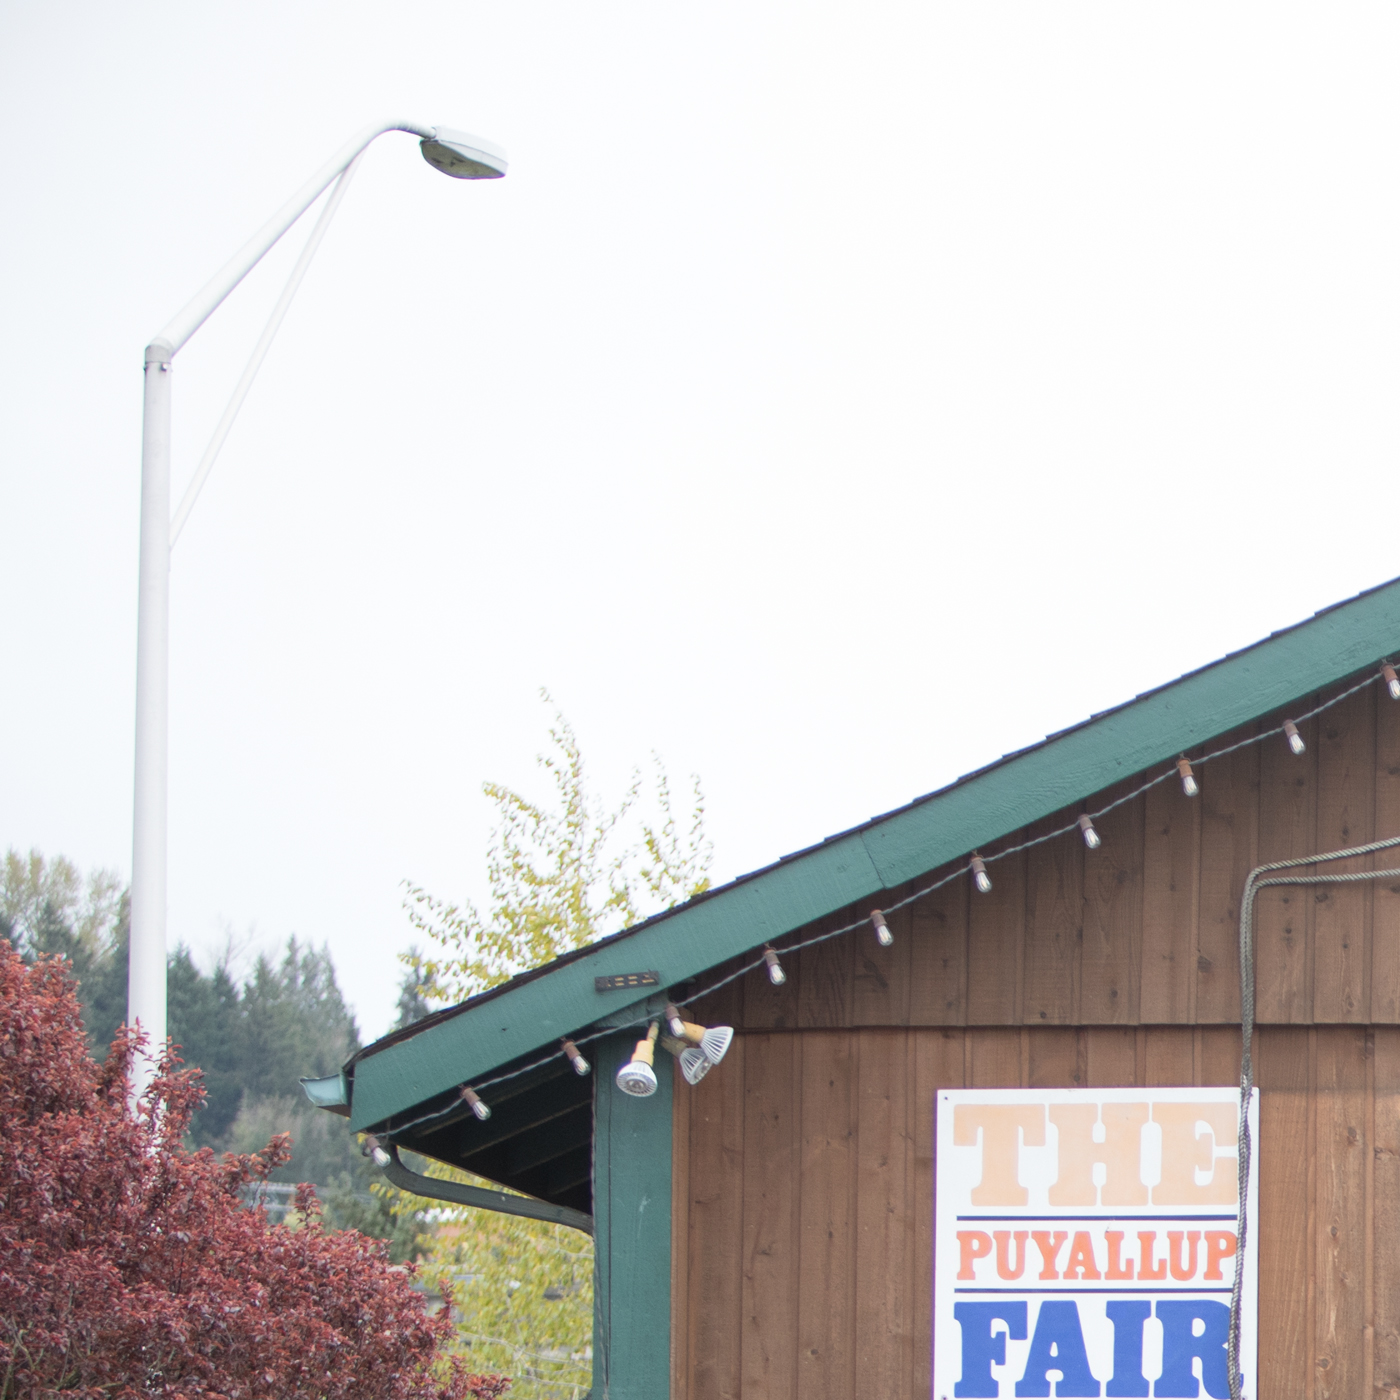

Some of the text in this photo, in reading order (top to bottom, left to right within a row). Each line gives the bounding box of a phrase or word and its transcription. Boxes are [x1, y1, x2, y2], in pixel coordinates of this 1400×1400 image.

[953, 1102, 1238, 1206] THE
[956, 1230, 1239, 1281] PUYALLUP
[953, 1299, 1244, 1400] FAIR
